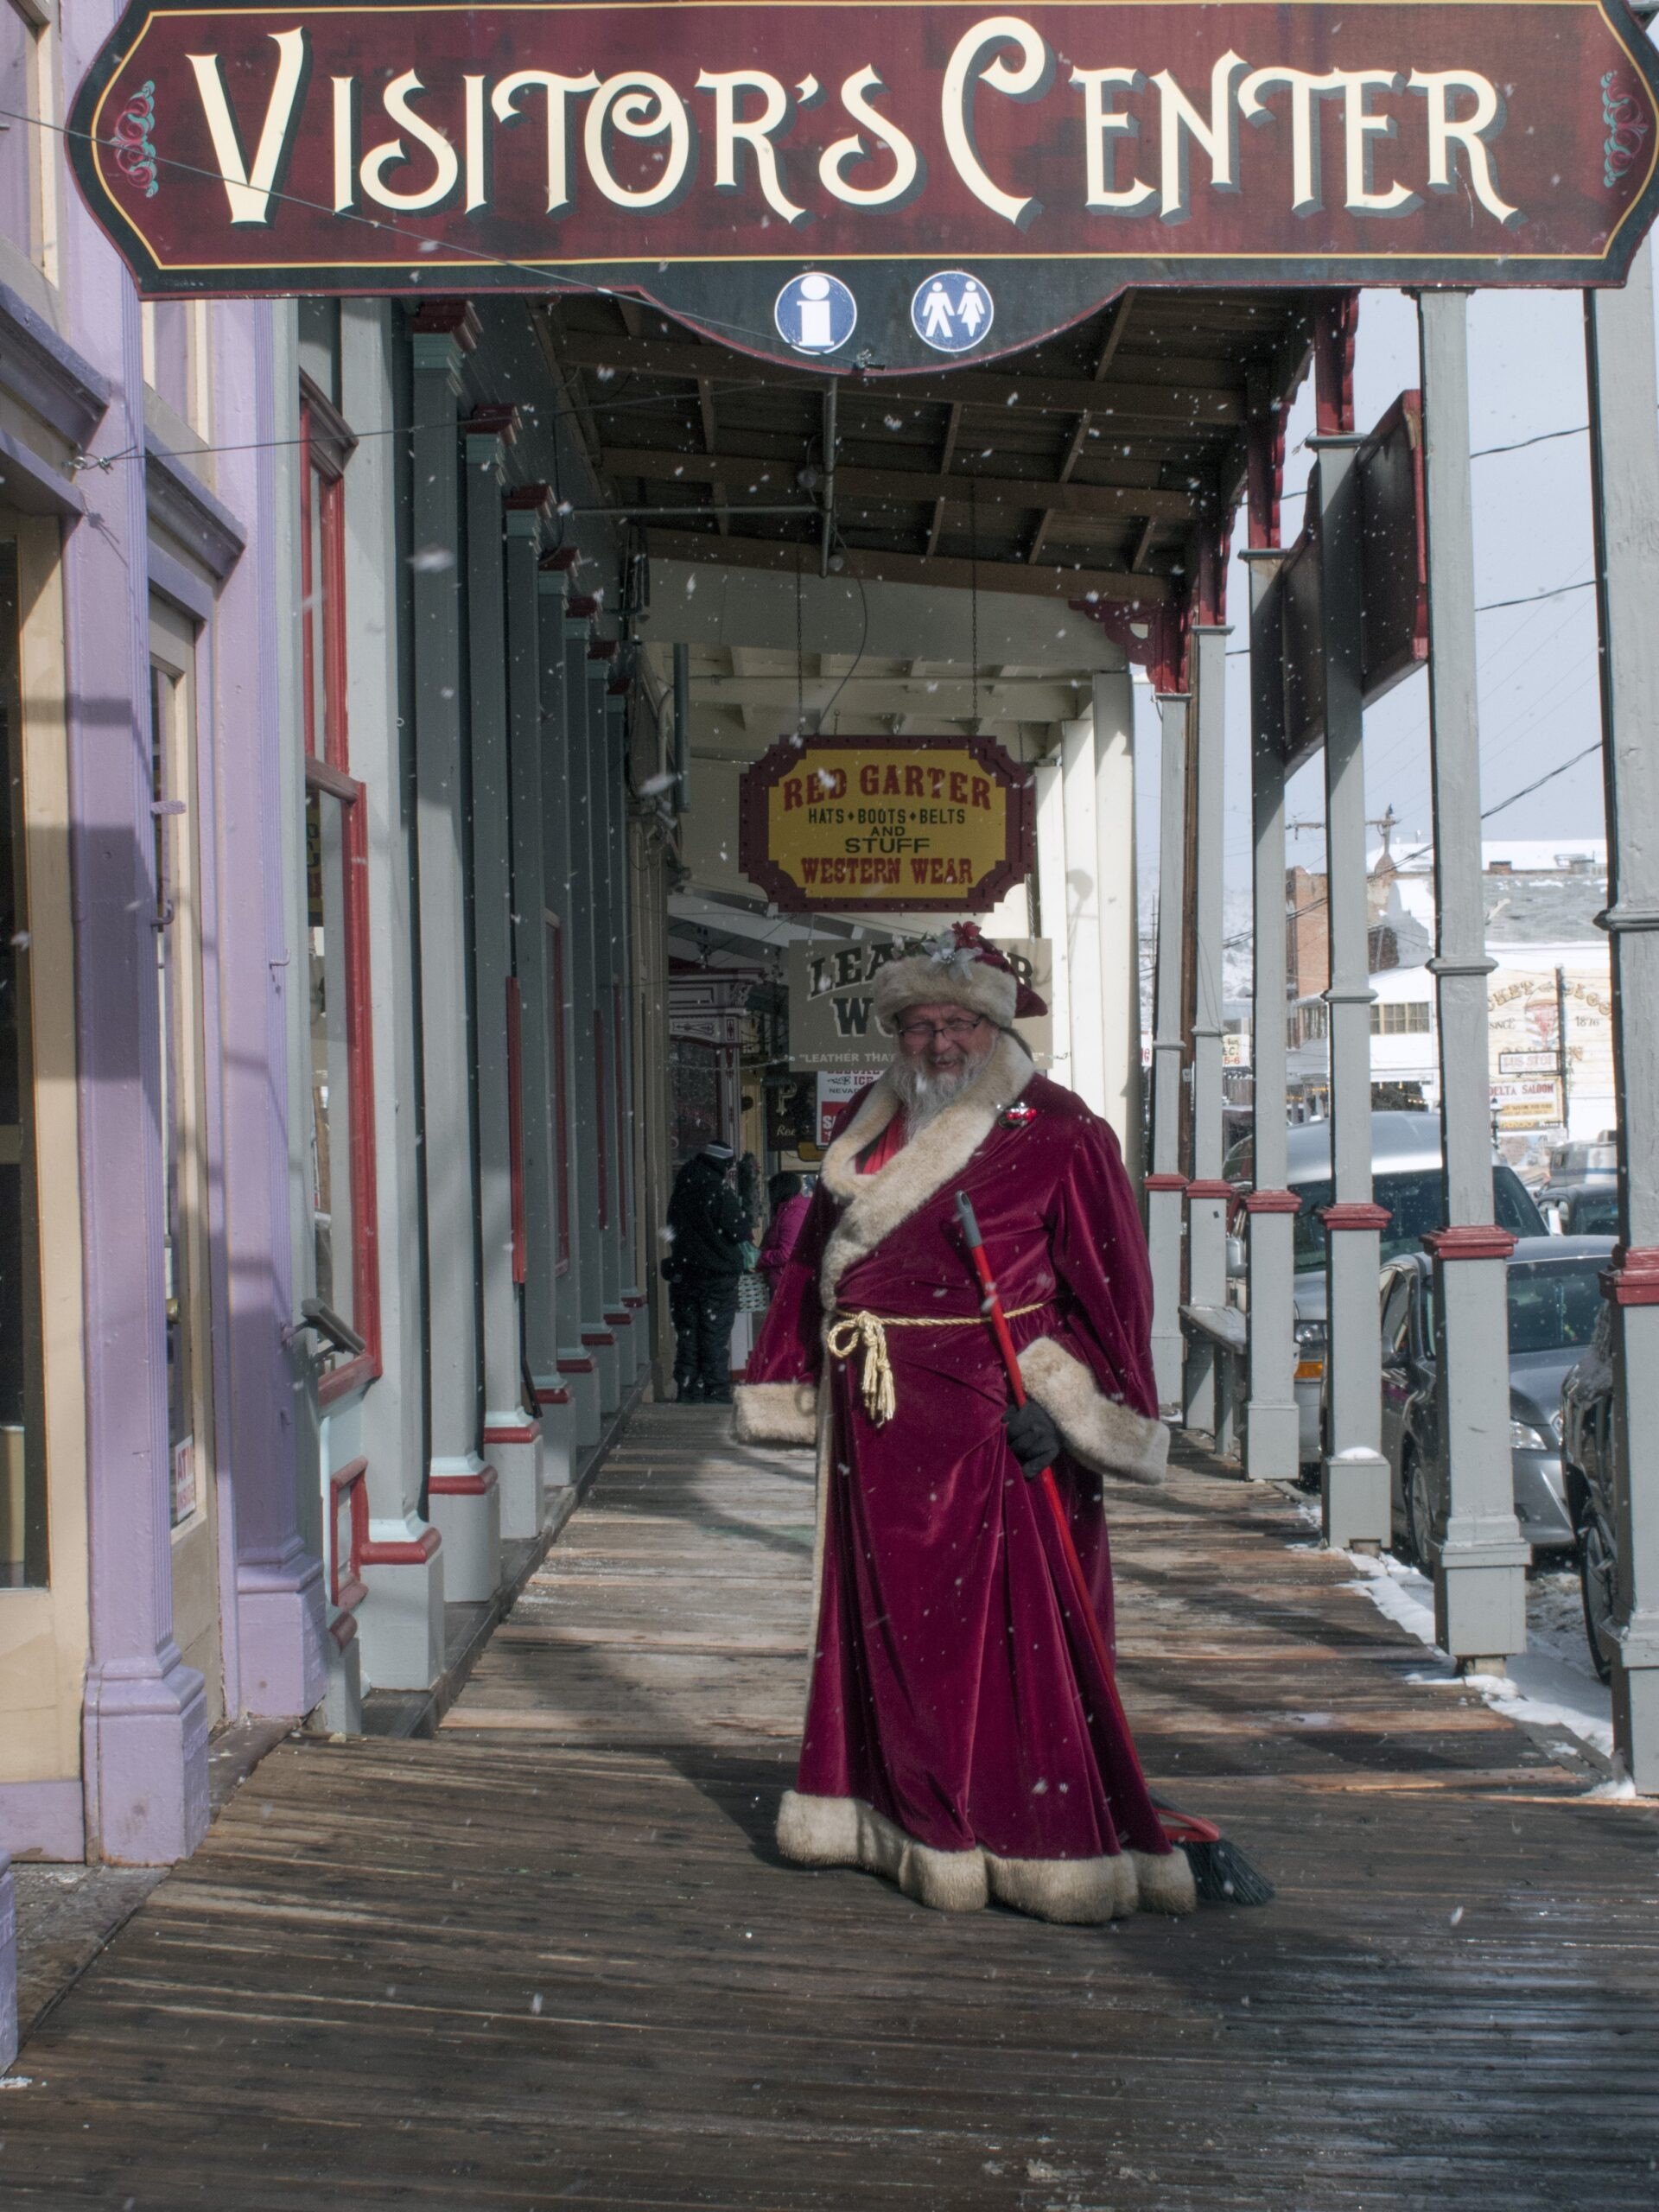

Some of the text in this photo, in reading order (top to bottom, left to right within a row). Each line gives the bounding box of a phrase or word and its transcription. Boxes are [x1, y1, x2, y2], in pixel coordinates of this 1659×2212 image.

[185, 16, 1520, 226] VISITOR'S CENTER
[783, 764, 992, 811] RED GARTER
[808, 808, 965, 825] HATS BOOTS BELTS
[870, 826, 906, 837] AND
[845, 837, 930, 854] STUFF
[801, 857, 973, 885] WESTERN WEAR
[1489, 1083, 1554, 1096] DELTA SALOON
